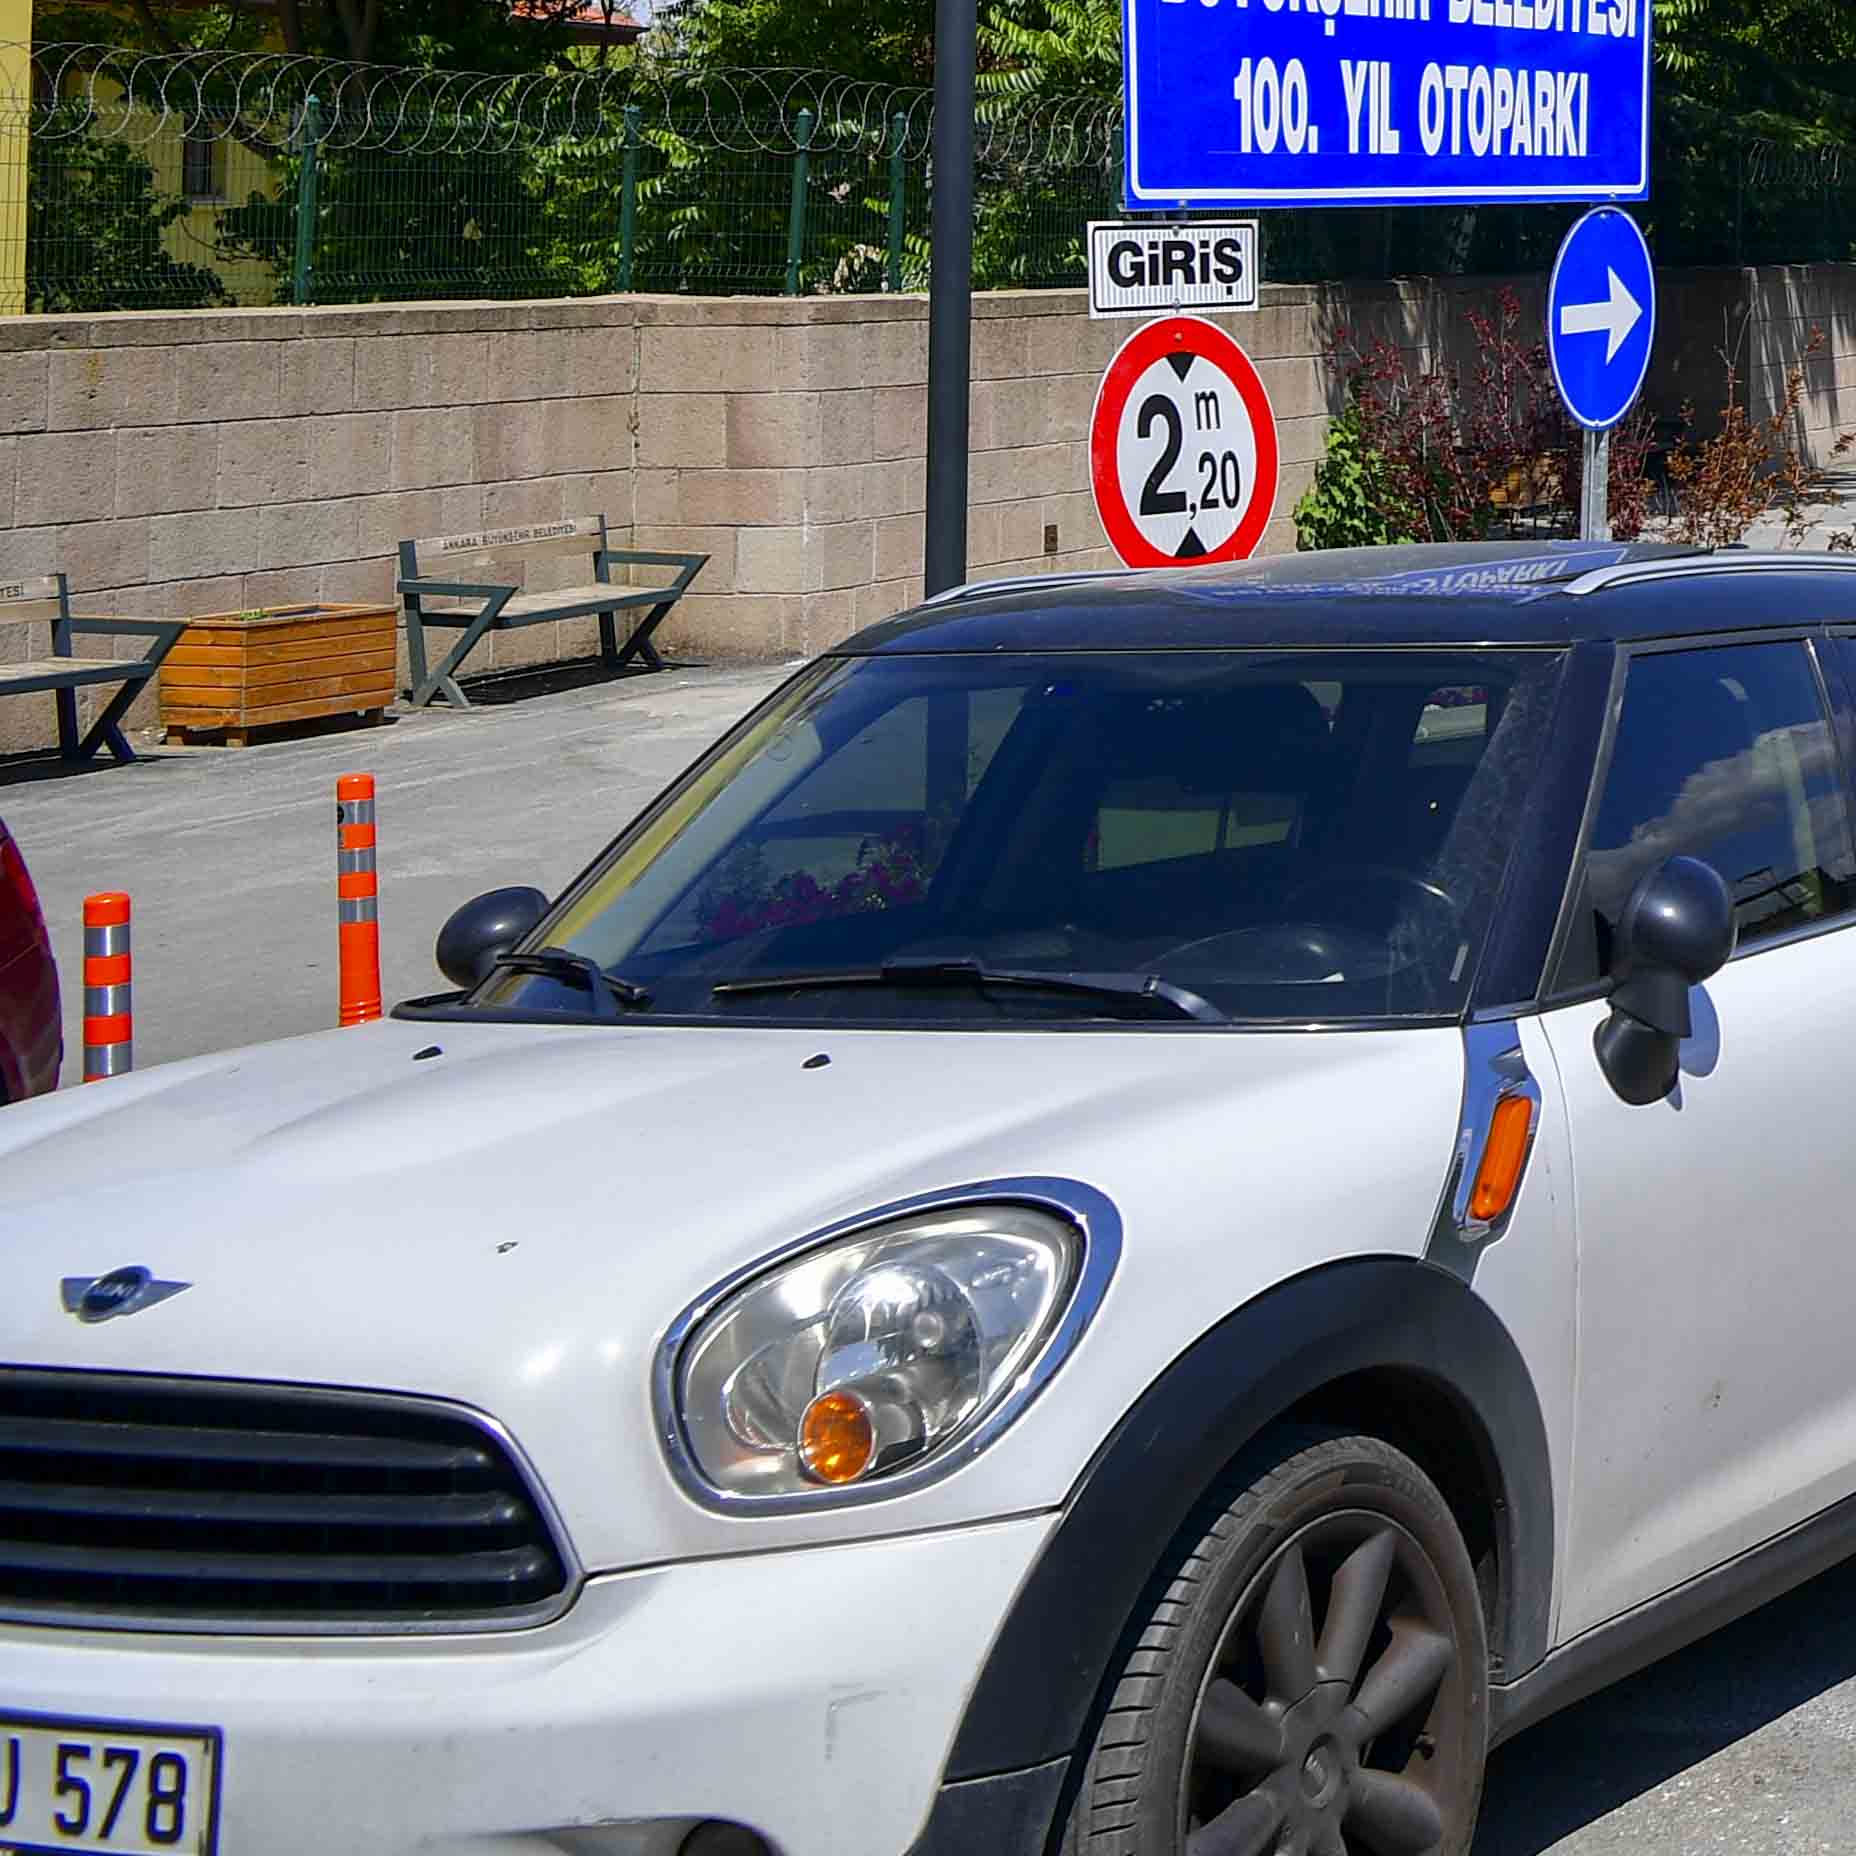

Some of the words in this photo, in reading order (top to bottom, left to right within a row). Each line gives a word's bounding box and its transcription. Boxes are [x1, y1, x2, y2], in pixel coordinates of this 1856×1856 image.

[1234, 57, 1318, 154] 100.
[1340, 60, 1399, 155] YIL
[1419, 62, 1588, 157] OTOPARKI
[54, 1743, 187, 1845] 578
